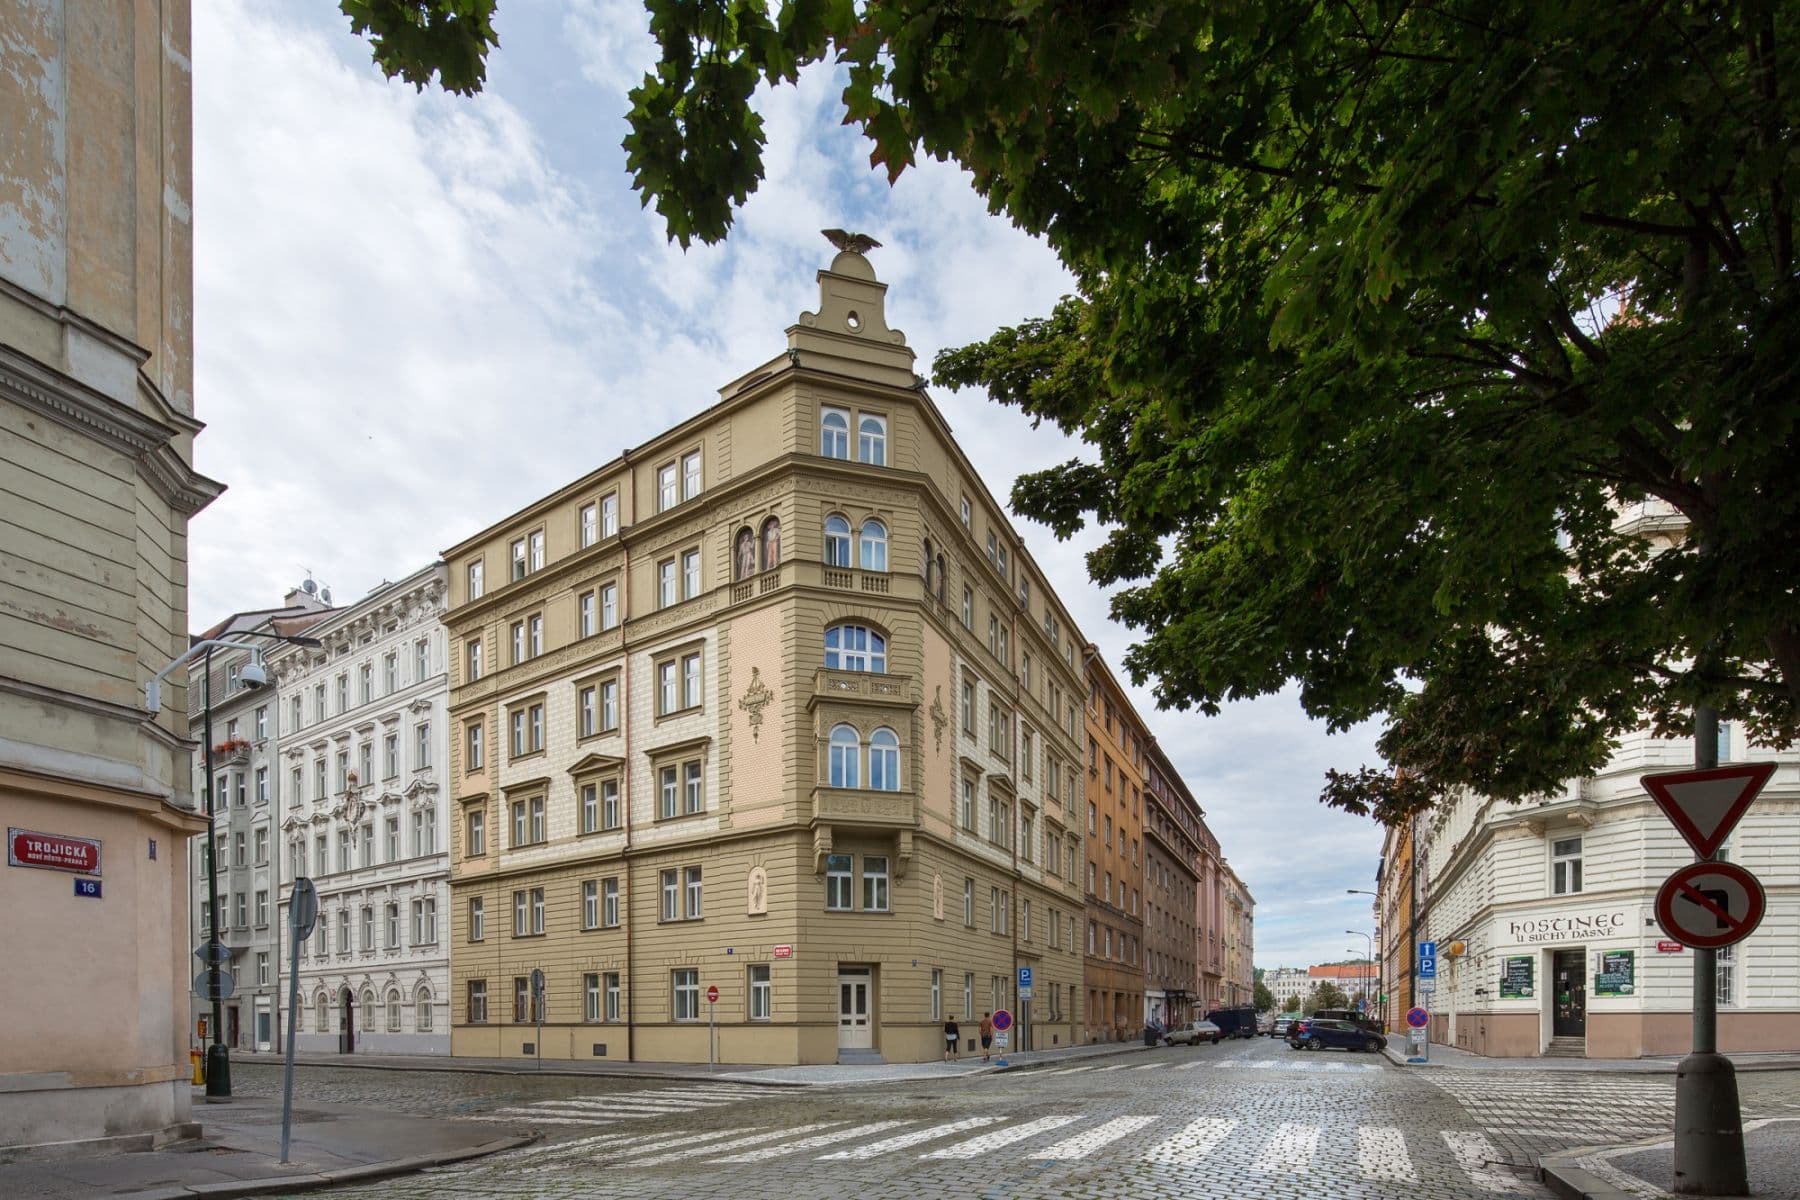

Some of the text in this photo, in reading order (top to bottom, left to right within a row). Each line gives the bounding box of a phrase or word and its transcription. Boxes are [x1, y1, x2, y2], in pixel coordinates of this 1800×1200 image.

[27, 840, 87, 858] TROJICKÁ
[82, 883, 95, 893] 16
[1422, 960, 1432, 972] P
[1022, 970, 1029, 980] P
